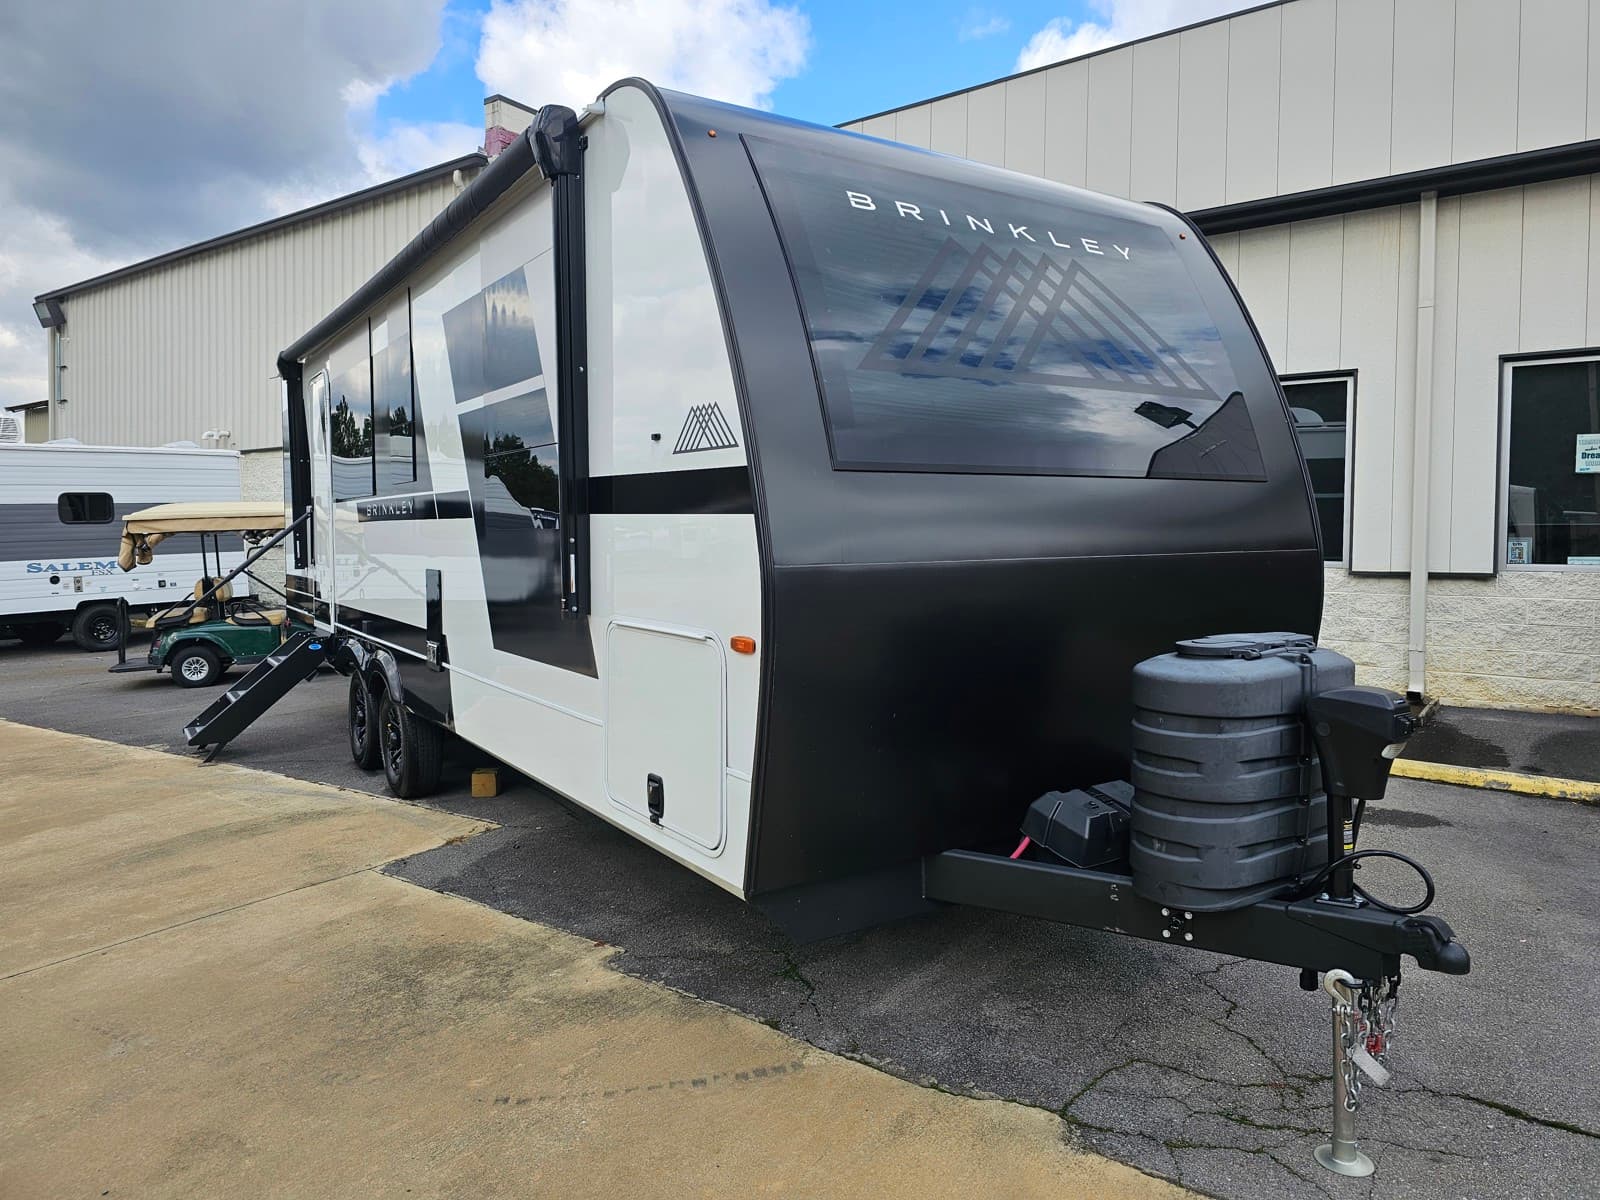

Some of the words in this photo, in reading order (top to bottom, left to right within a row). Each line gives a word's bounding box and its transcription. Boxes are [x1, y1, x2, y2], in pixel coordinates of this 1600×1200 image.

[845, 190, 1132, 260] BRINKLEY
[366, 501, 414, 516] BRINKLEY
[26, 561, 118, 573] SALEM
